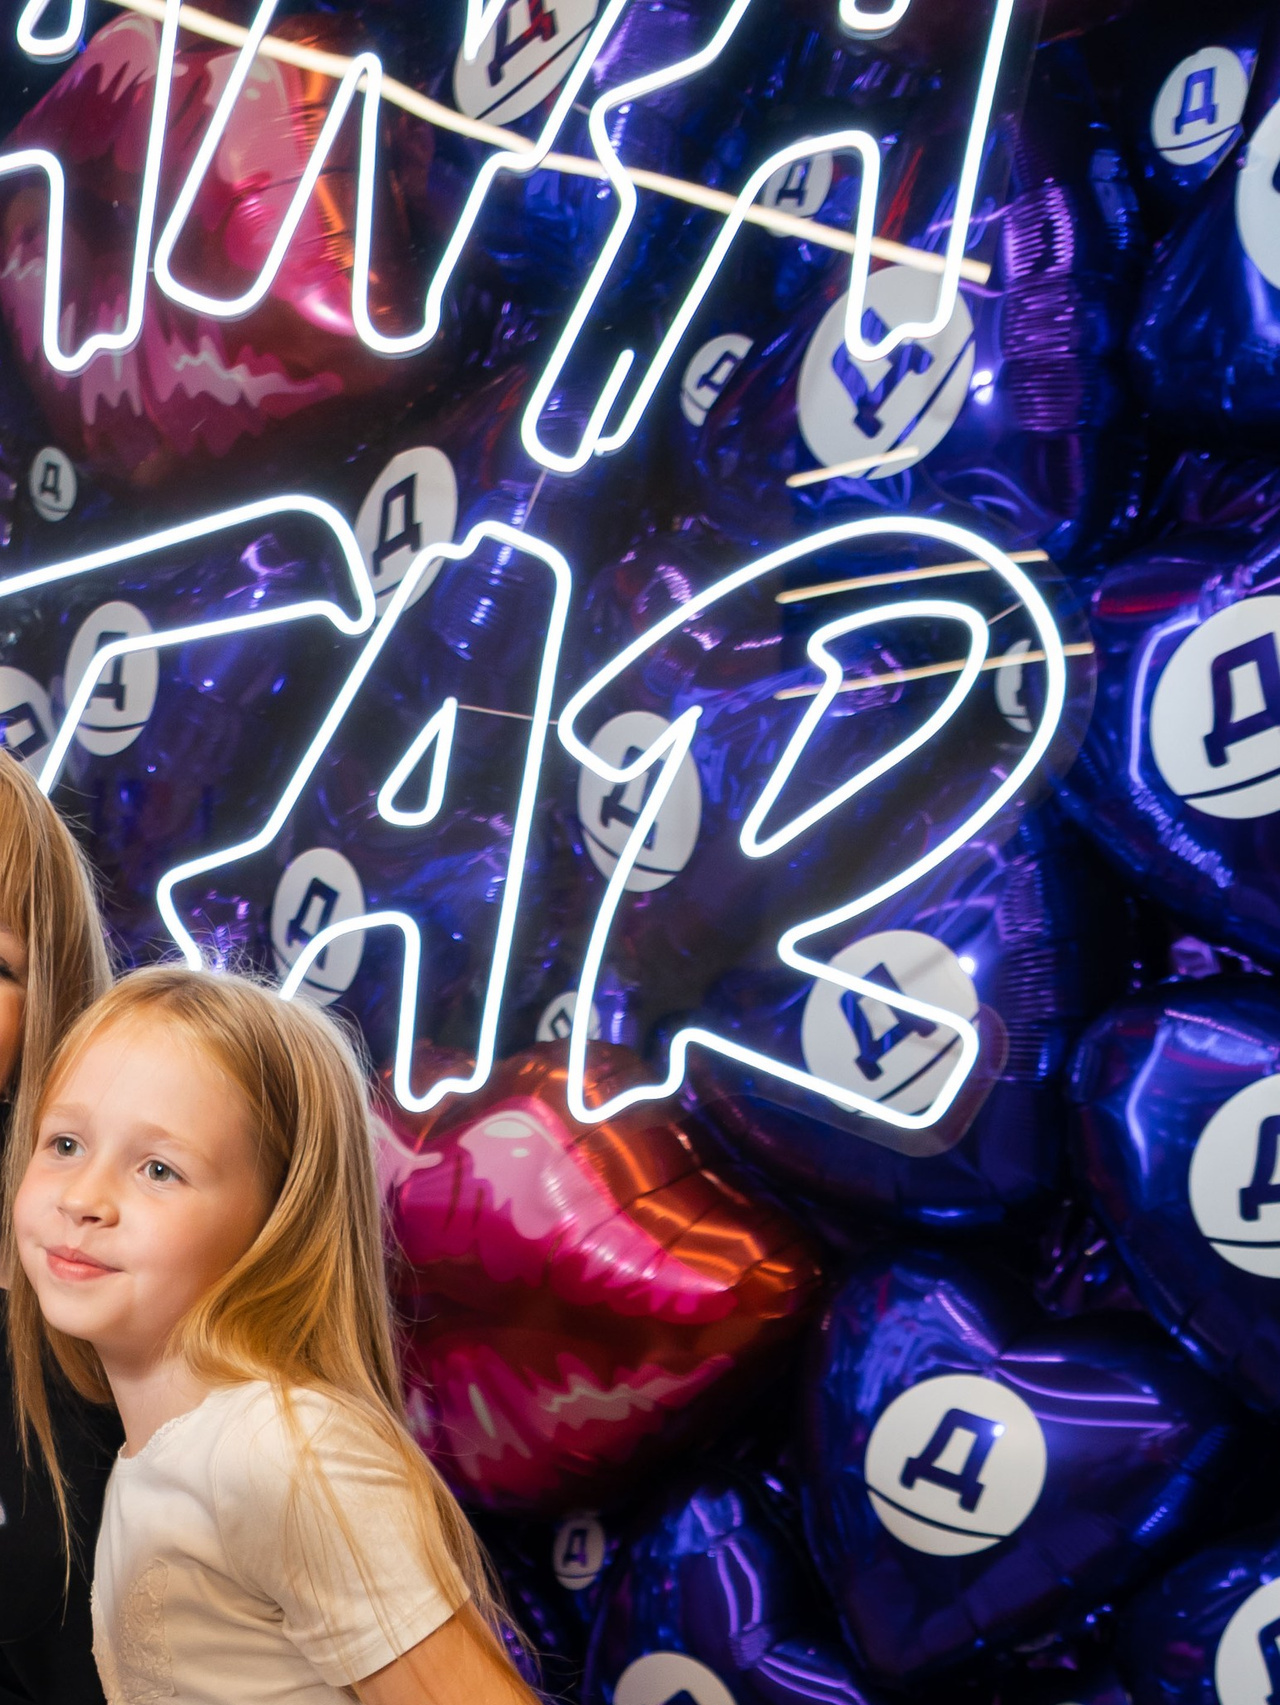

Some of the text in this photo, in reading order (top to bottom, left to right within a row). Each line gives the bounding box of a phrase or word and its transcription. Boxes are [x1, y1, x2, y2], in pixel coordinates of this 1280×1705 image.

[1175, 67, 1217, 134] Д
[777, 155, 809, 211] Д
[41, 460, 62, 501] Д
[372, 472, 421, 577] Д
[1204, 633, 1280, 767] Д
[287, 878, 340, 971] Д
[840, 963, 938, 1080] Д
[900, 1408, 1004, 1513] Д
